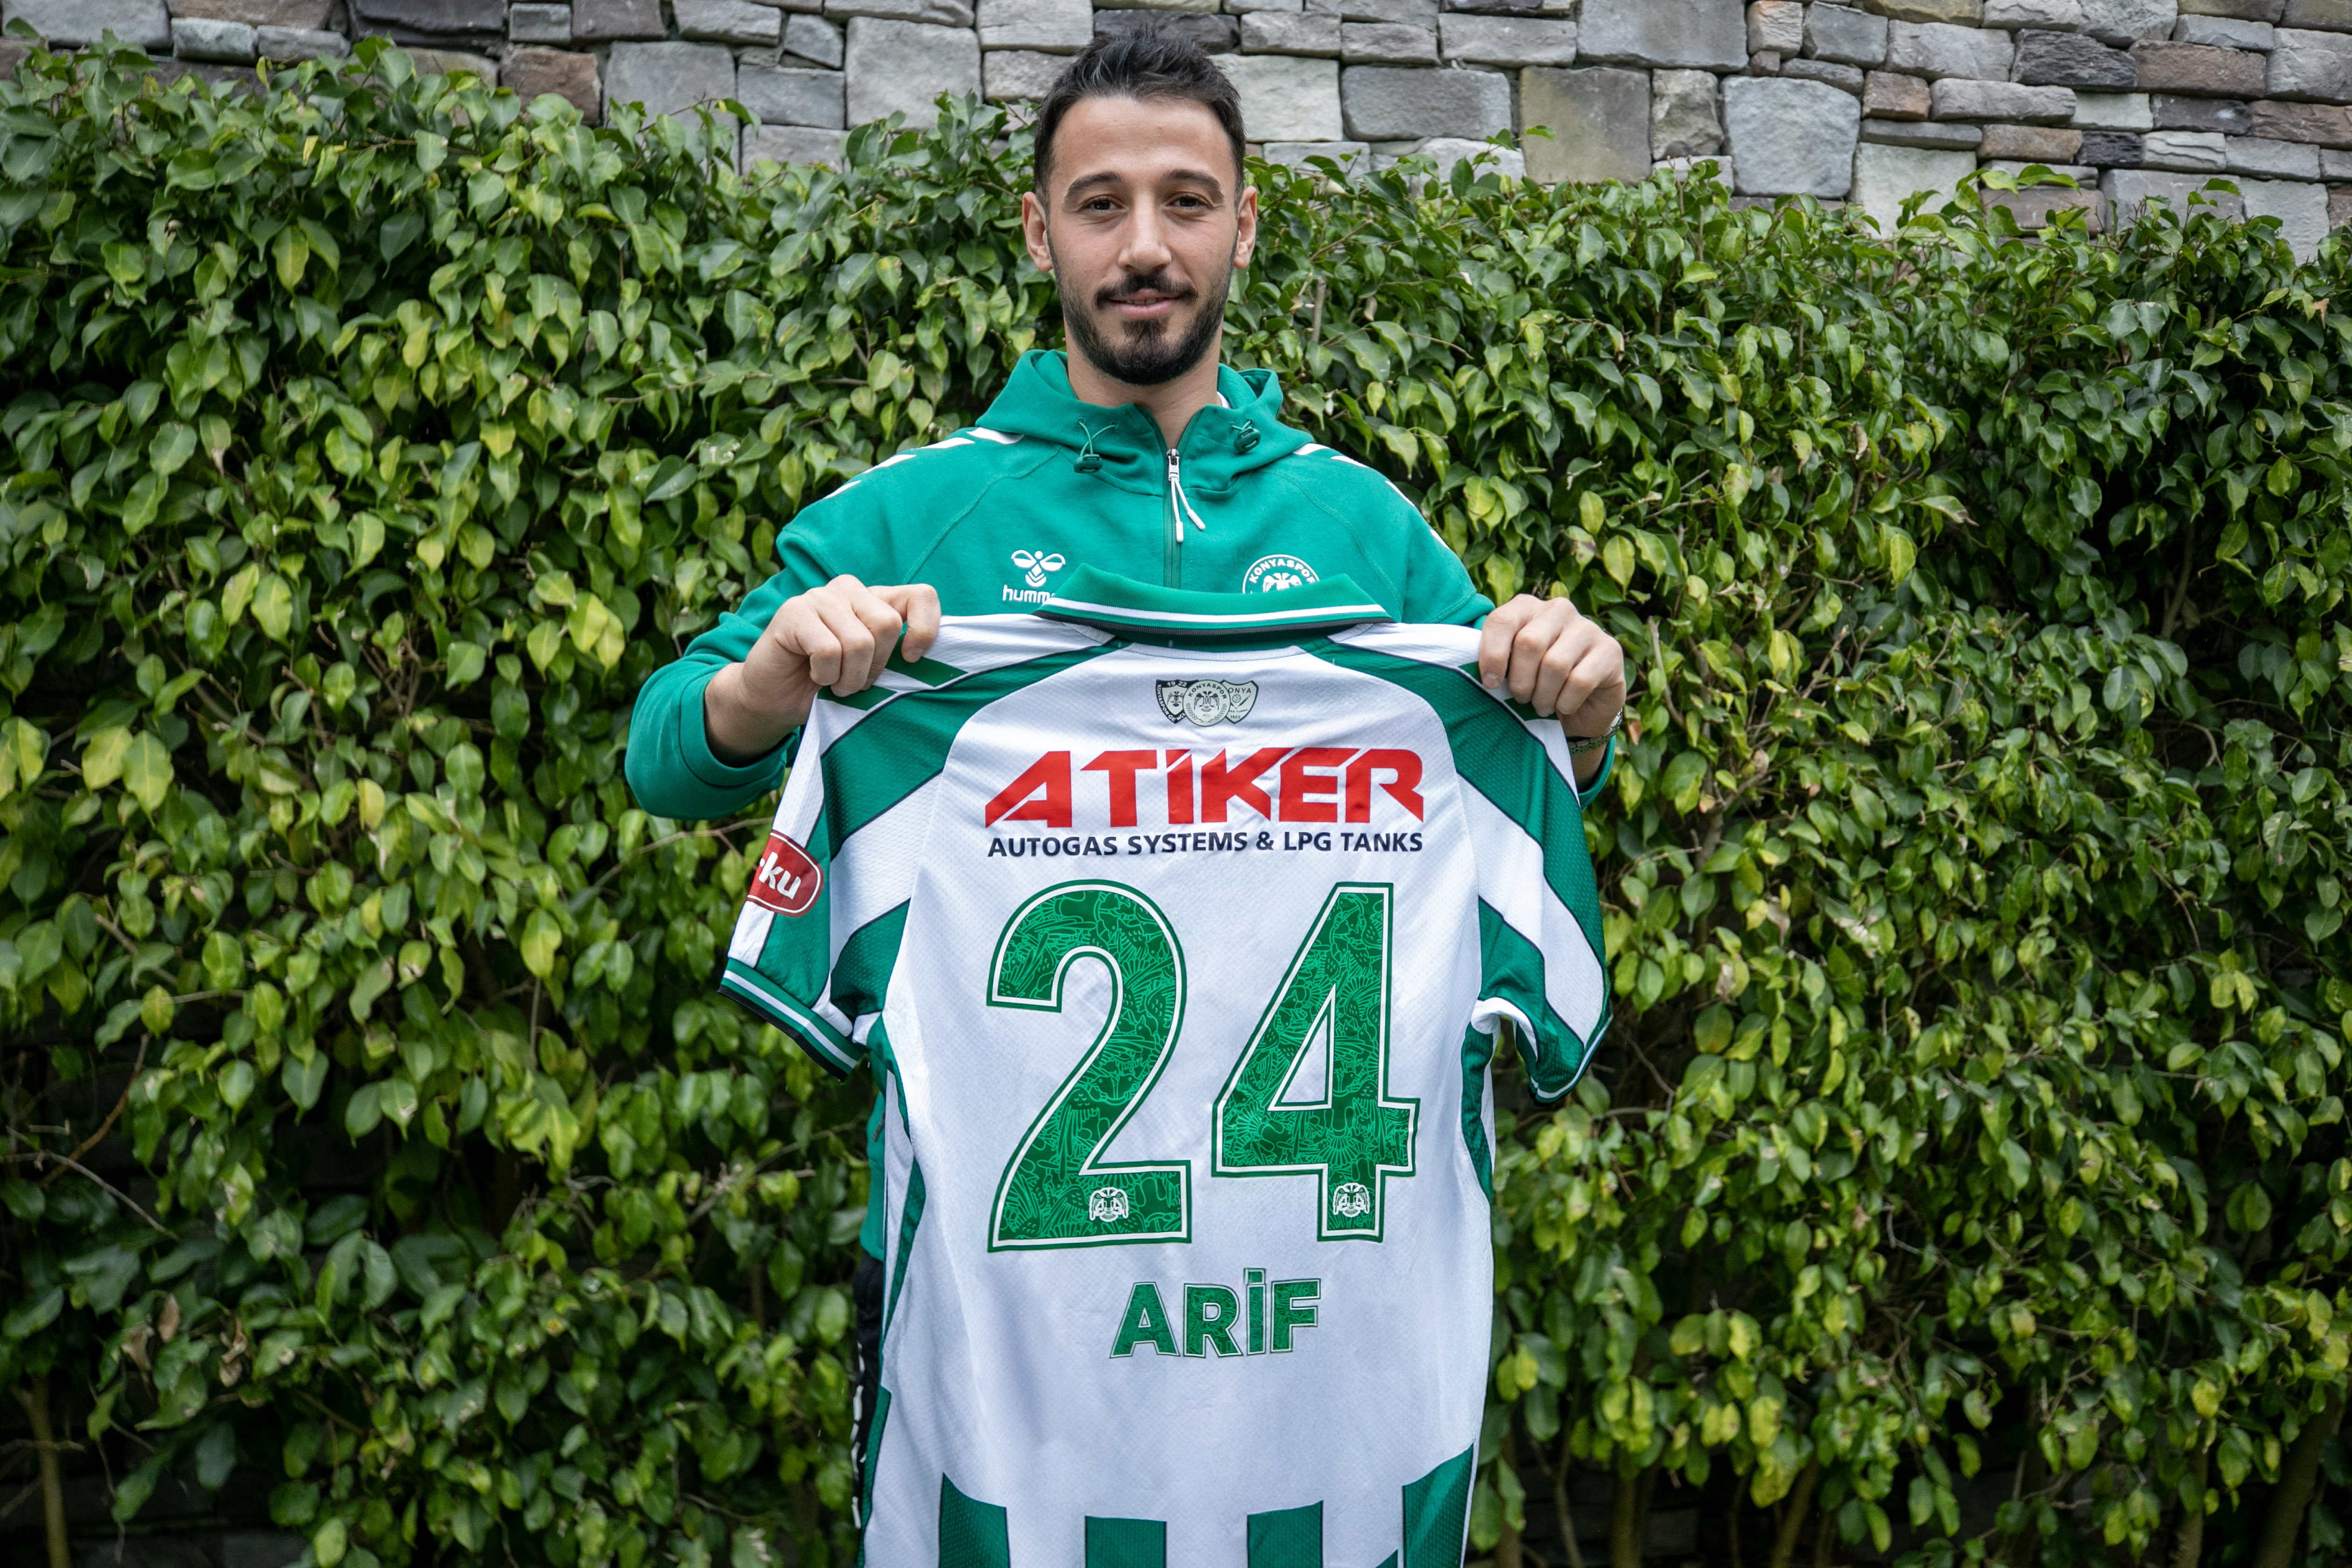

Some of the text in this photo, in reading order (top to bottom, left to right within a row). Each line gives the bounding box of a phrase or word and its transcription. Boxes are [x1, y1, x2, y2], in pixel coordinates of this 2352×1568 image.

[1002, 584, 1055, 604] humm
[1156, 684, 1169, 715] KONYASPOR
[1188, 683, 1227, 699] KONYASPOR
[987, 831, 1423, 857] AUTOGAS SYSTEMS & LPG TANKS
[759, 851, 801, 900] ku
[987, 879, 1420, 1253] 24
